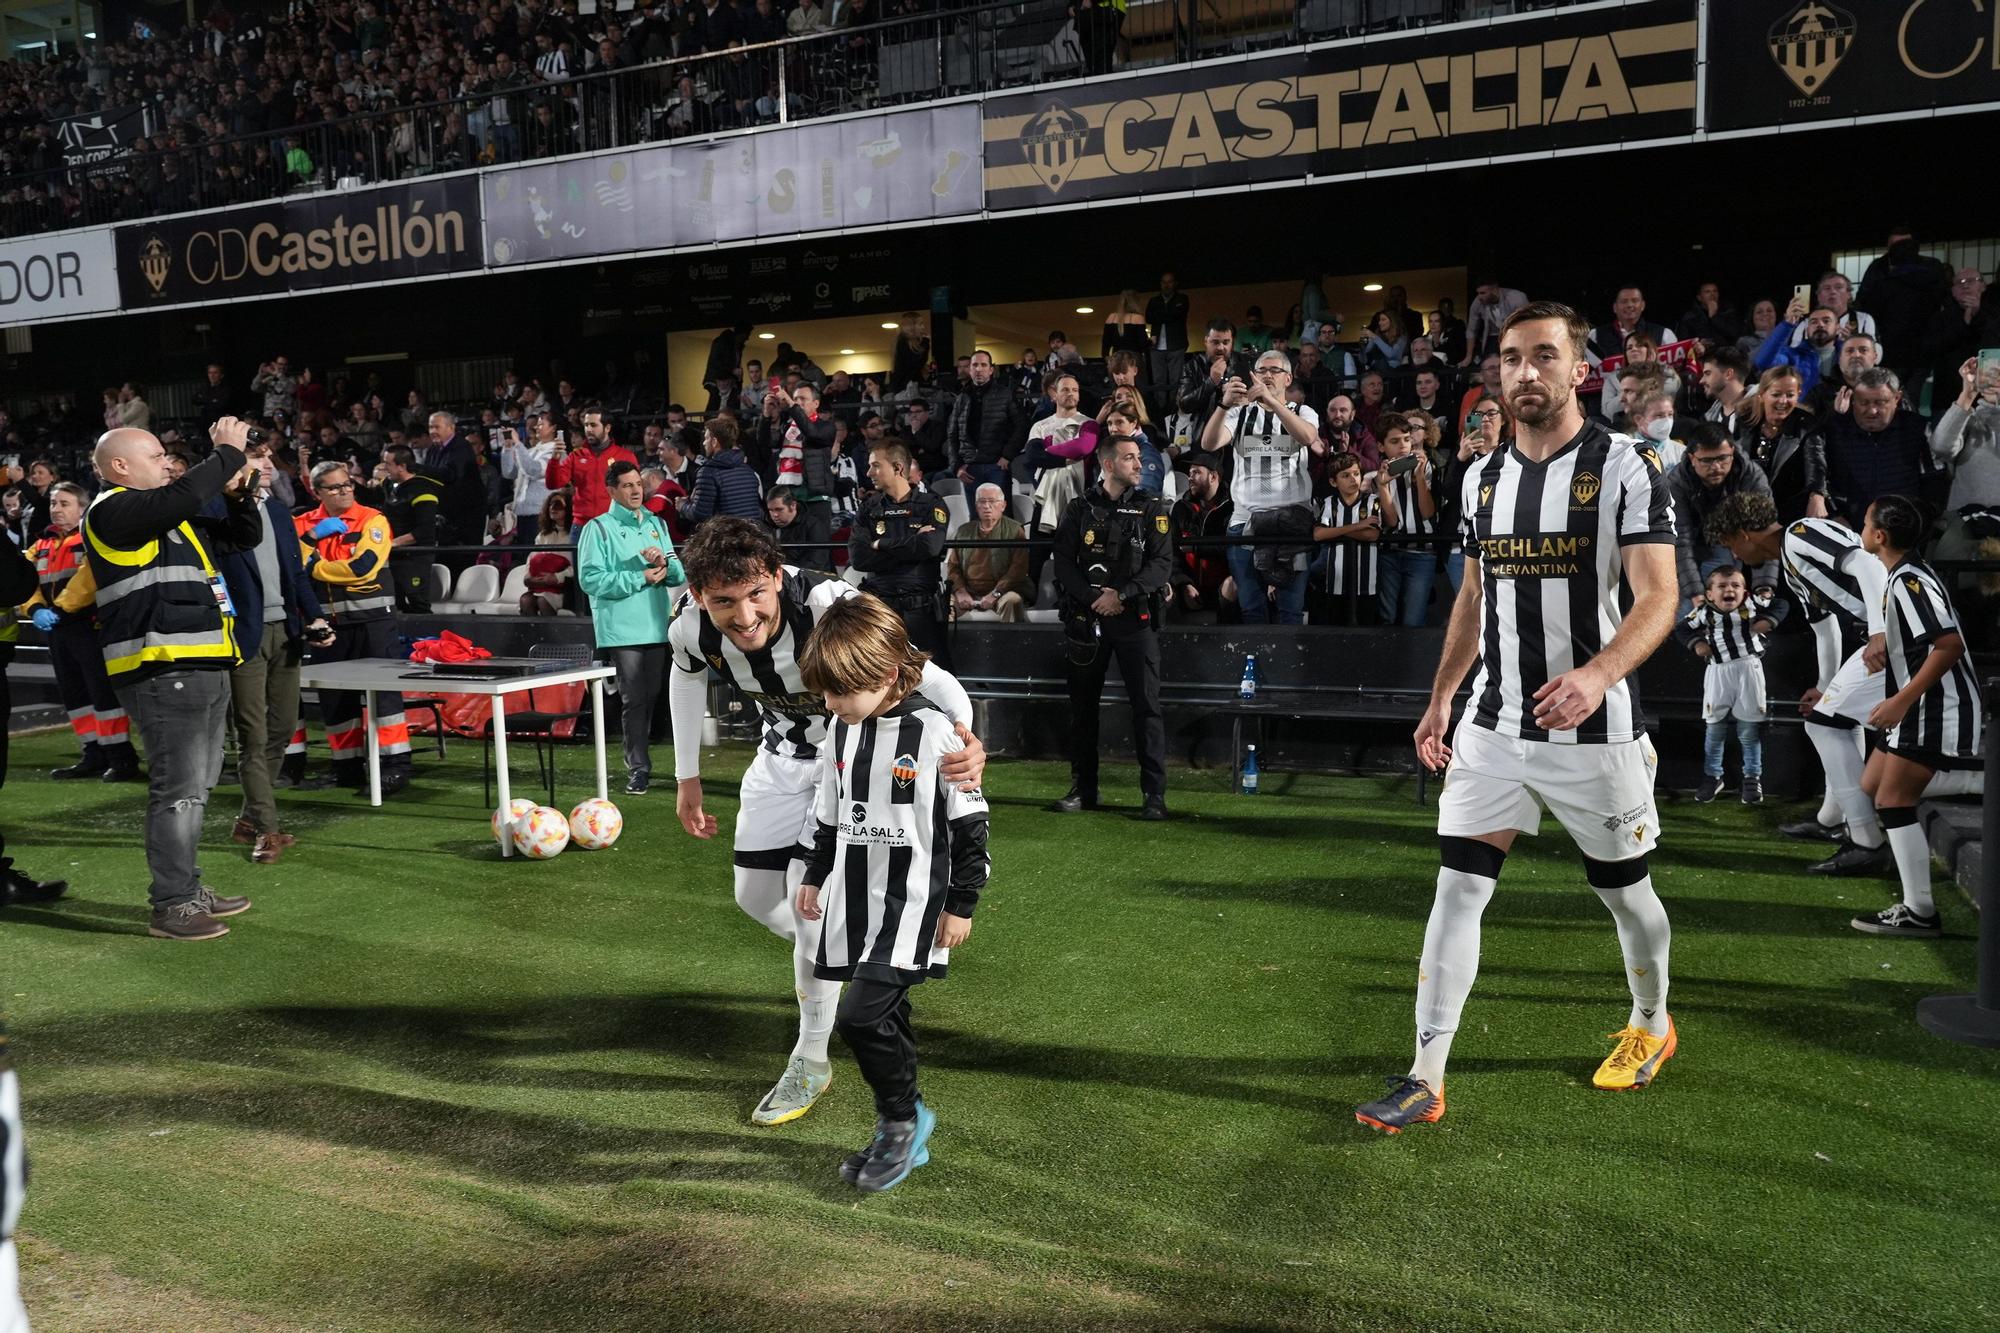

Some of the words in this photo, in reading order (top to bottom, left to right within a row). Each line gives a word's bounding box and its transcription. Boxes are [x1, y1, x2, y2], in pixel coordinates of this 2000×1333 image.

[1898, 0, 2000, 79] C
[1103, 32, 1638, 175] CASTALIA
[1789, 99, 1806, 108] 1922
[1813, 96, 1831, 106] 2022
[0, 251, 83, 306] DOR
[1500, 563, 1578, 575] LEVANTINA
[852, 826, 868, 836] LA
[870, 826, 894, 838] SAL
[896, 828, 905, 838] 2
